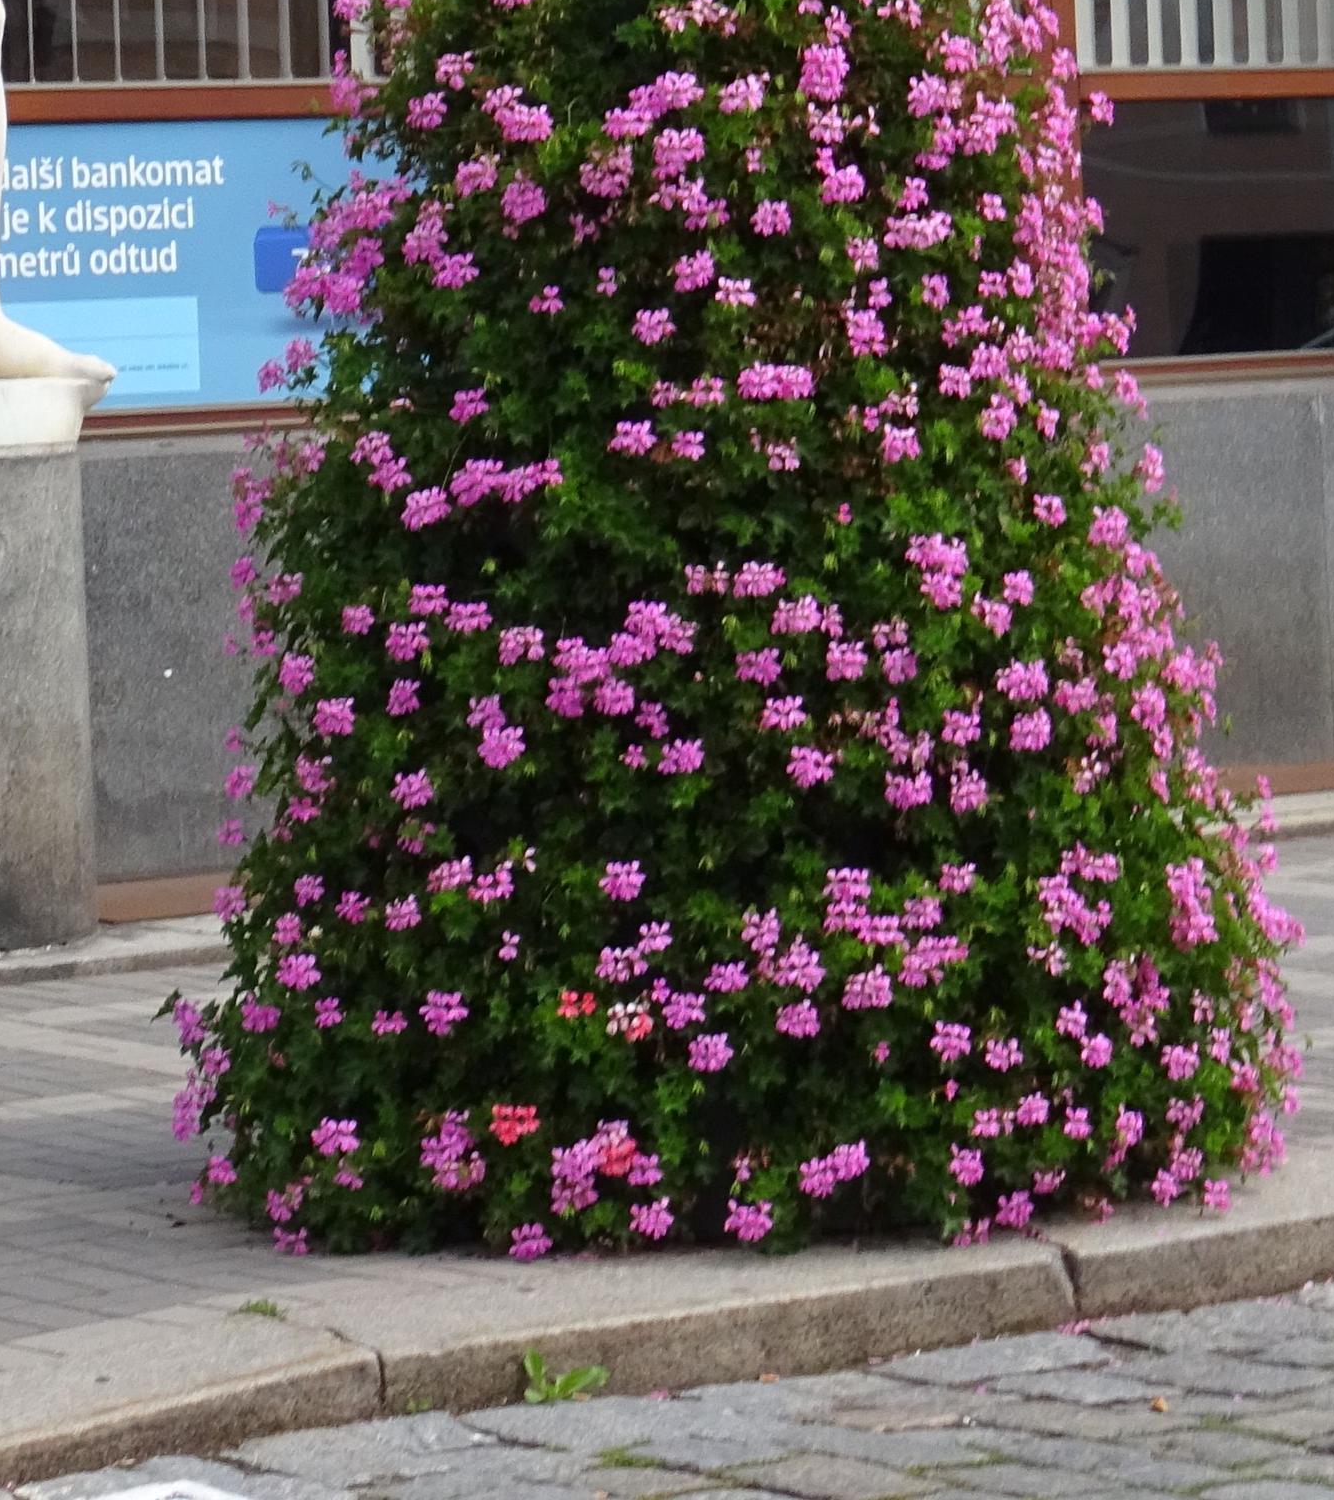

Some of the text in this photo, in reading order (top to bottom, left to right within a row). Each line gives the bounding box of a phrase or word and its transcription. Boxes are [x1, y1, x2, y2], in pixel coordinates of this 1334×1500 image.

[72, 154, 224, 189] bankomat
[1, 196, 194, 241] je k dispozici
[89, 240, 177, 275] odtud
